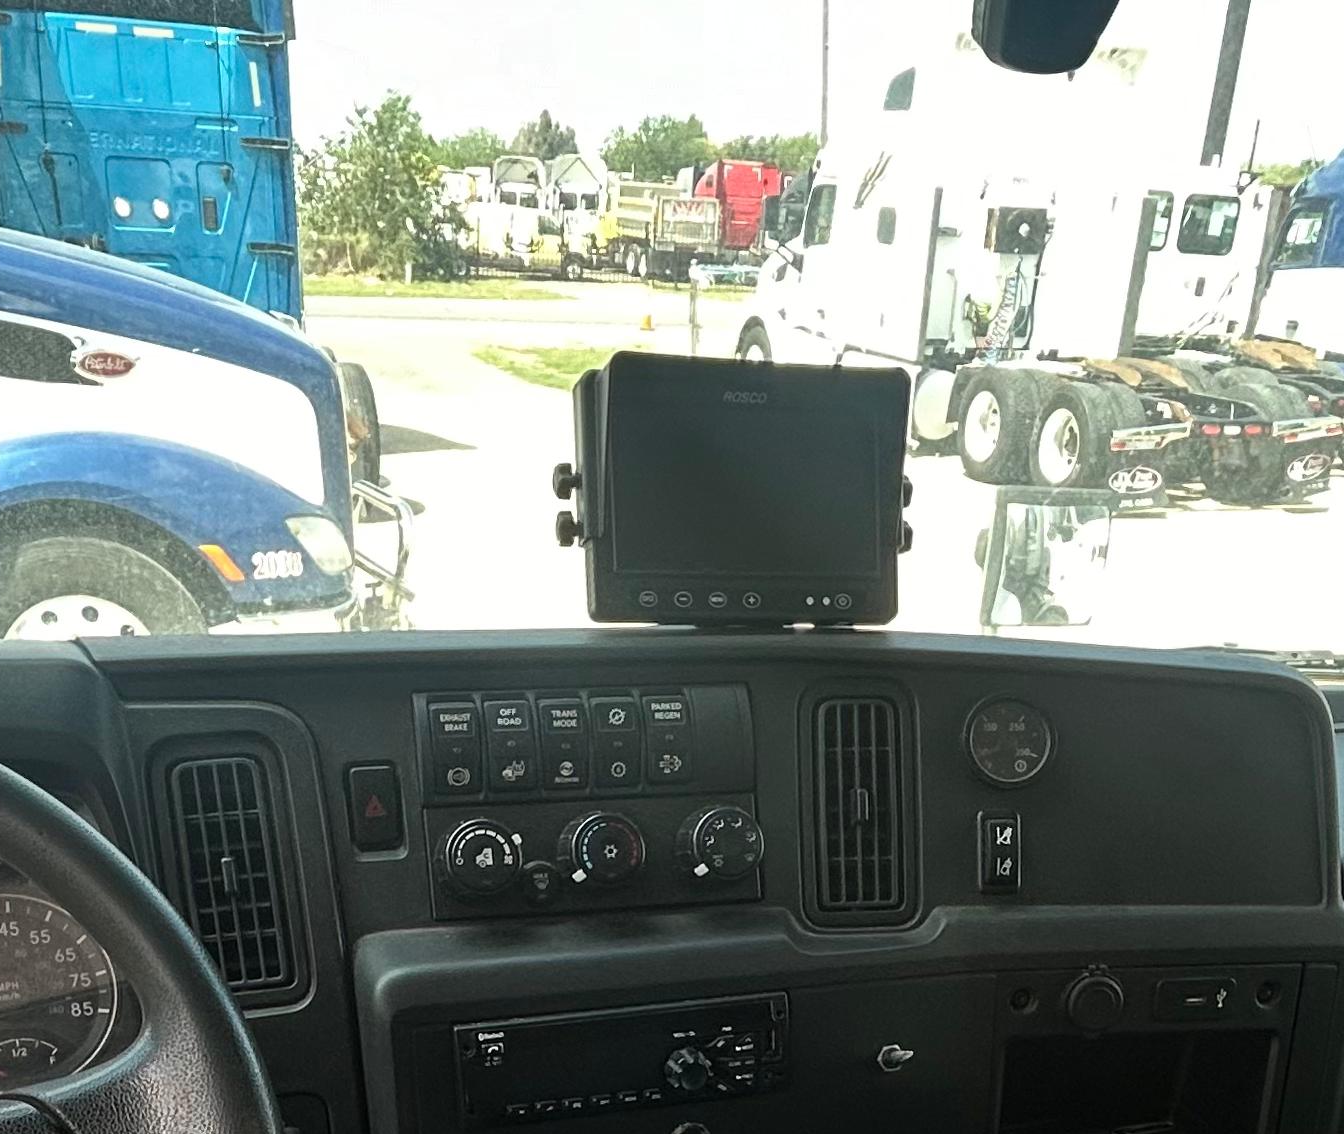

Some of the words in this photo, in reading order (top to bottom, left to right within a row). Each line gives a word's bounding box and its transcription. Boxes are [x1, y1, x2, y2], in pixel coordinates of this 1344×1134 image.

[722, 391, 768, 404] ROSCO
[651, 702, 682, 711] PARKED
[499, 708, 516, 716] OFF
[550, 710, 578, 719] TRANS
[654, 711, 681, 720] REGEN
[497, 717, 522, 726] ROAD
[552, 719, 578, 728] MODE
[444, 723, 468, 732] BRAKE
[29, 930, 51, 944] 55
[55, 948, 76, 962] 65
[69, 973, 92, 987] 75
[70, 1002, 94, 1016] 85
[12, 1048, 28, 1057] 1/2
